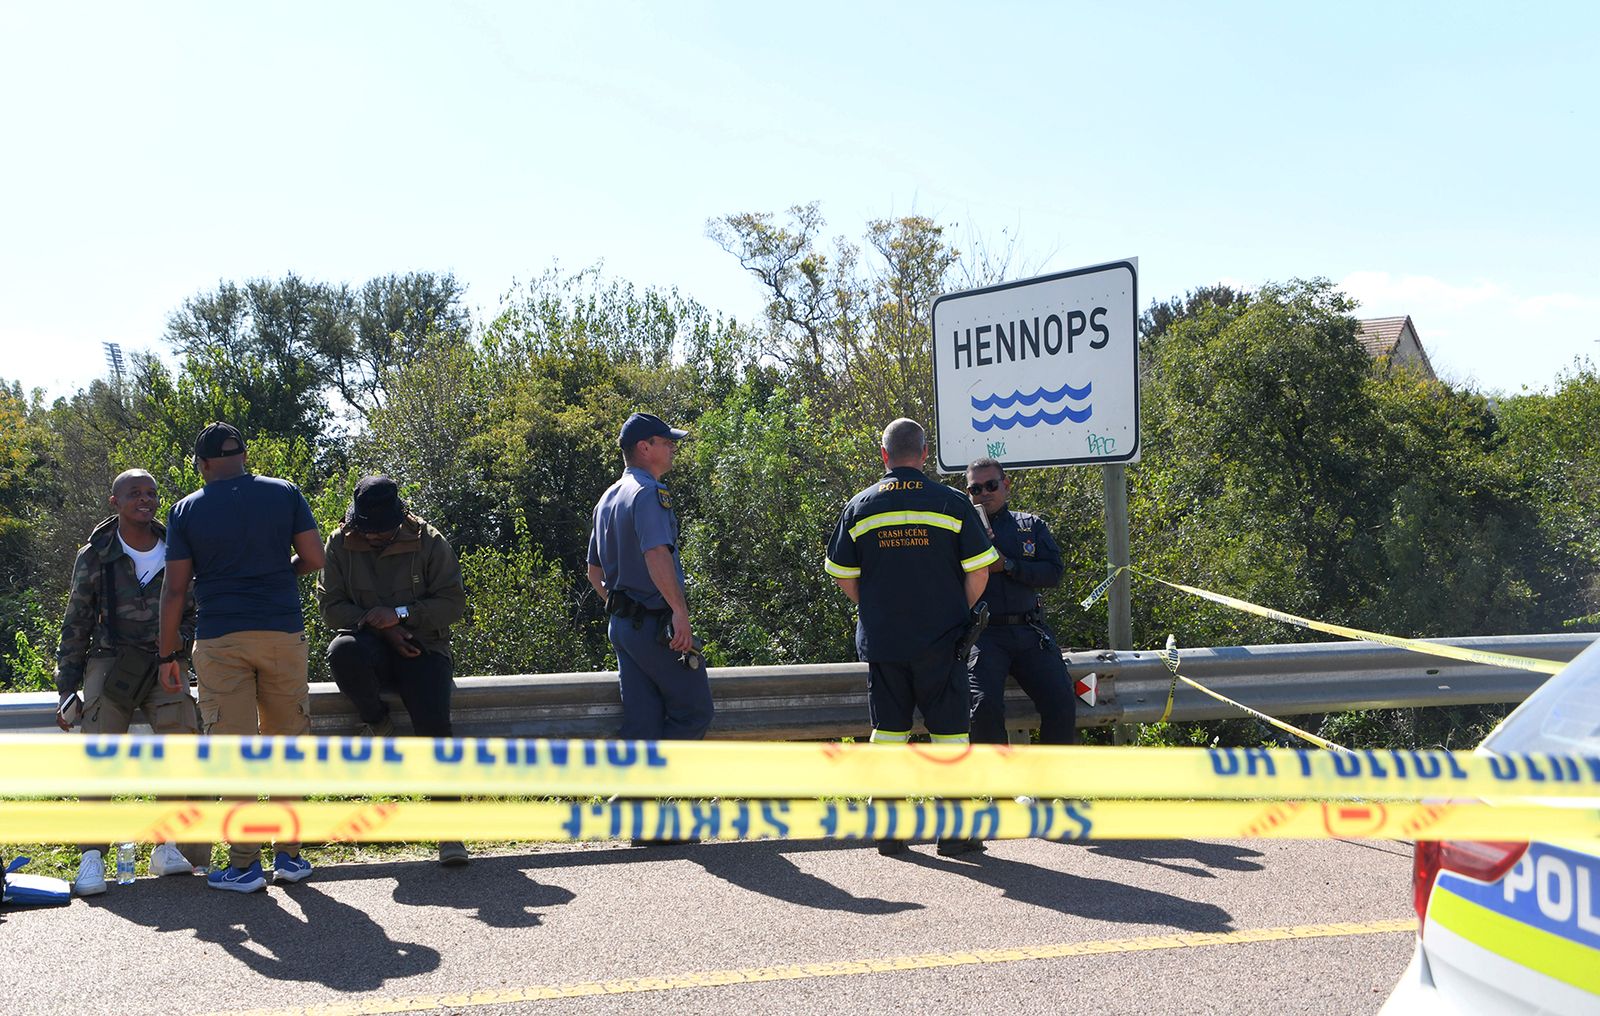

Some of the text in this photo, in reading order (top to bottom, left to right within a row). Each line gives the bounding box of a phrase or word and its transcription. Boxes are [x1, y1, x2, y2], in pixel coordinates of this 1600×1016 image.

[953, 306, 1110, 370] HENNOPS
[878, 480, 924, 492] POLICE
[877, 528, 928, 539] CRASH SCENE
[878, 538, 929, 548] INVESTIGATOR
[1503, 853, 1600, 935] POL
